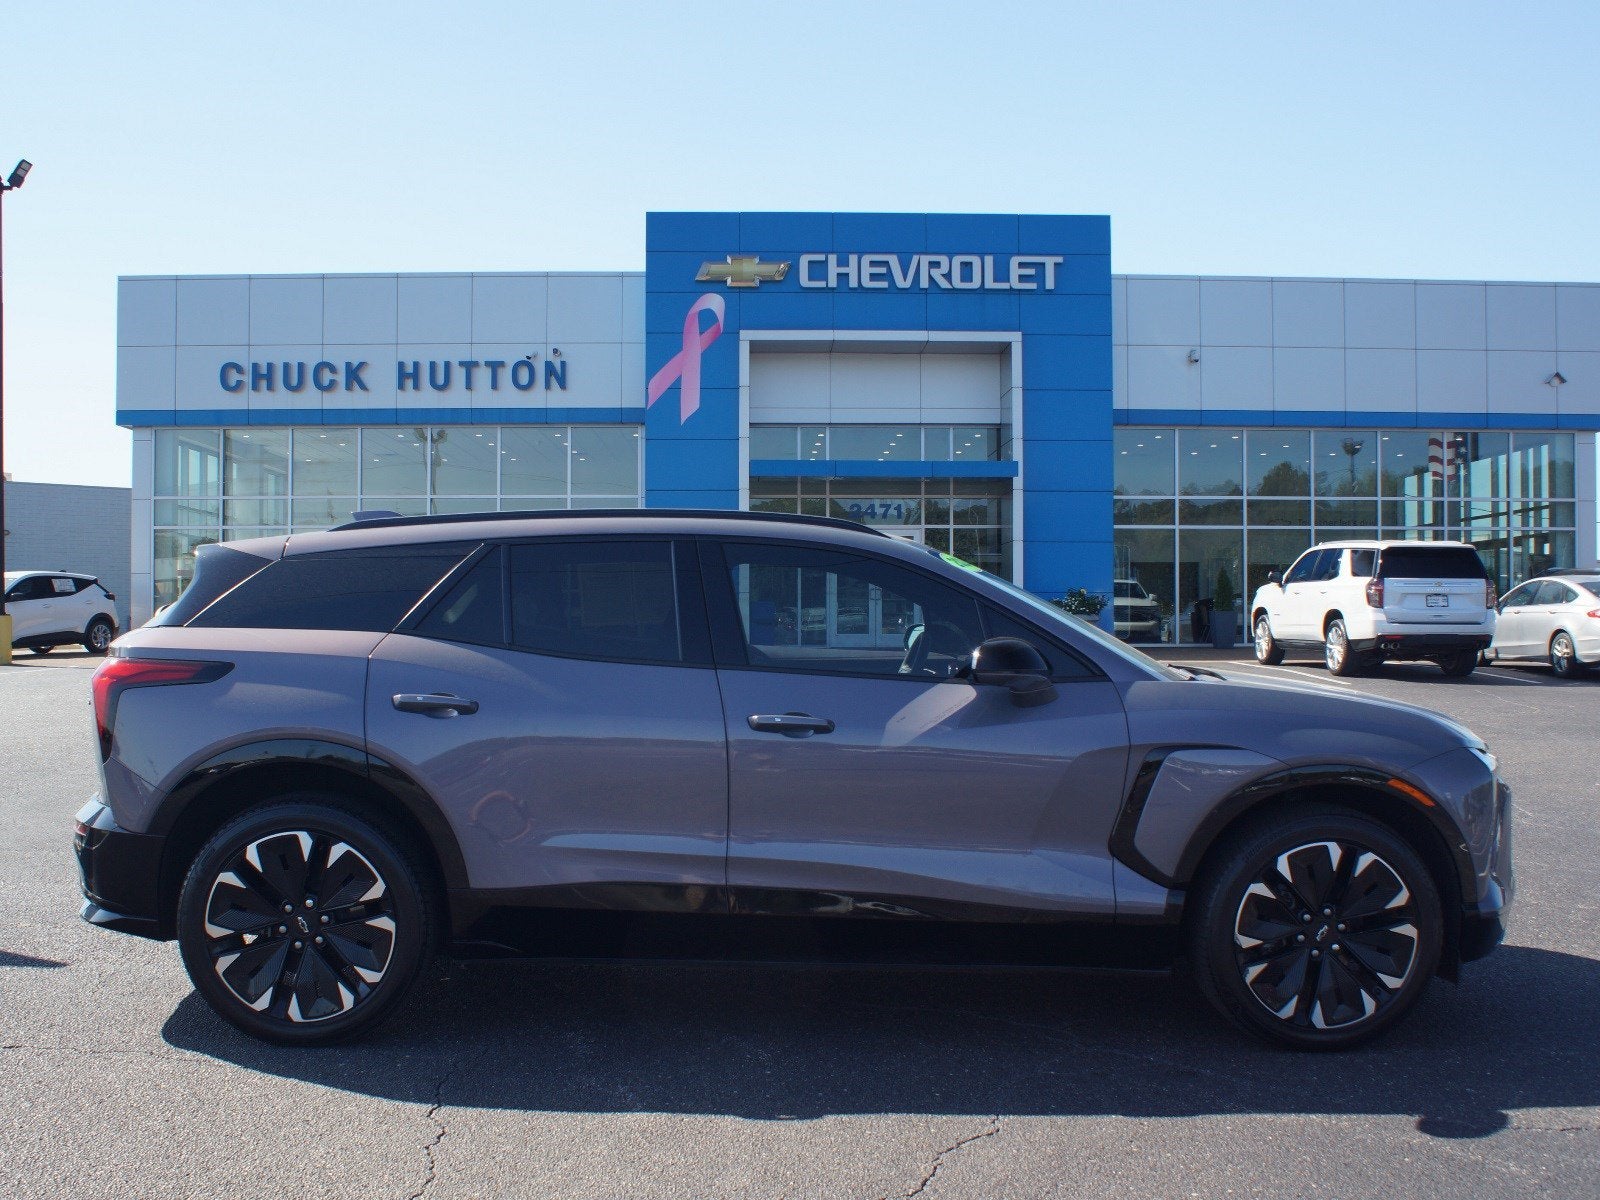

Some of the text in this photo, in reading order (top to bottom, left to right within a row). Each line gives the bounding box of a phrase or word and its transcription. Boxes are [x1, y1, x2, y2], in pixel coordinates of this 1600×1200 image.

[799, 254, 1064, 290] CHEVROLET
[219, 360, 567, 392] CHUCK HUTTON
[848, 503, 902, 519] 2471
